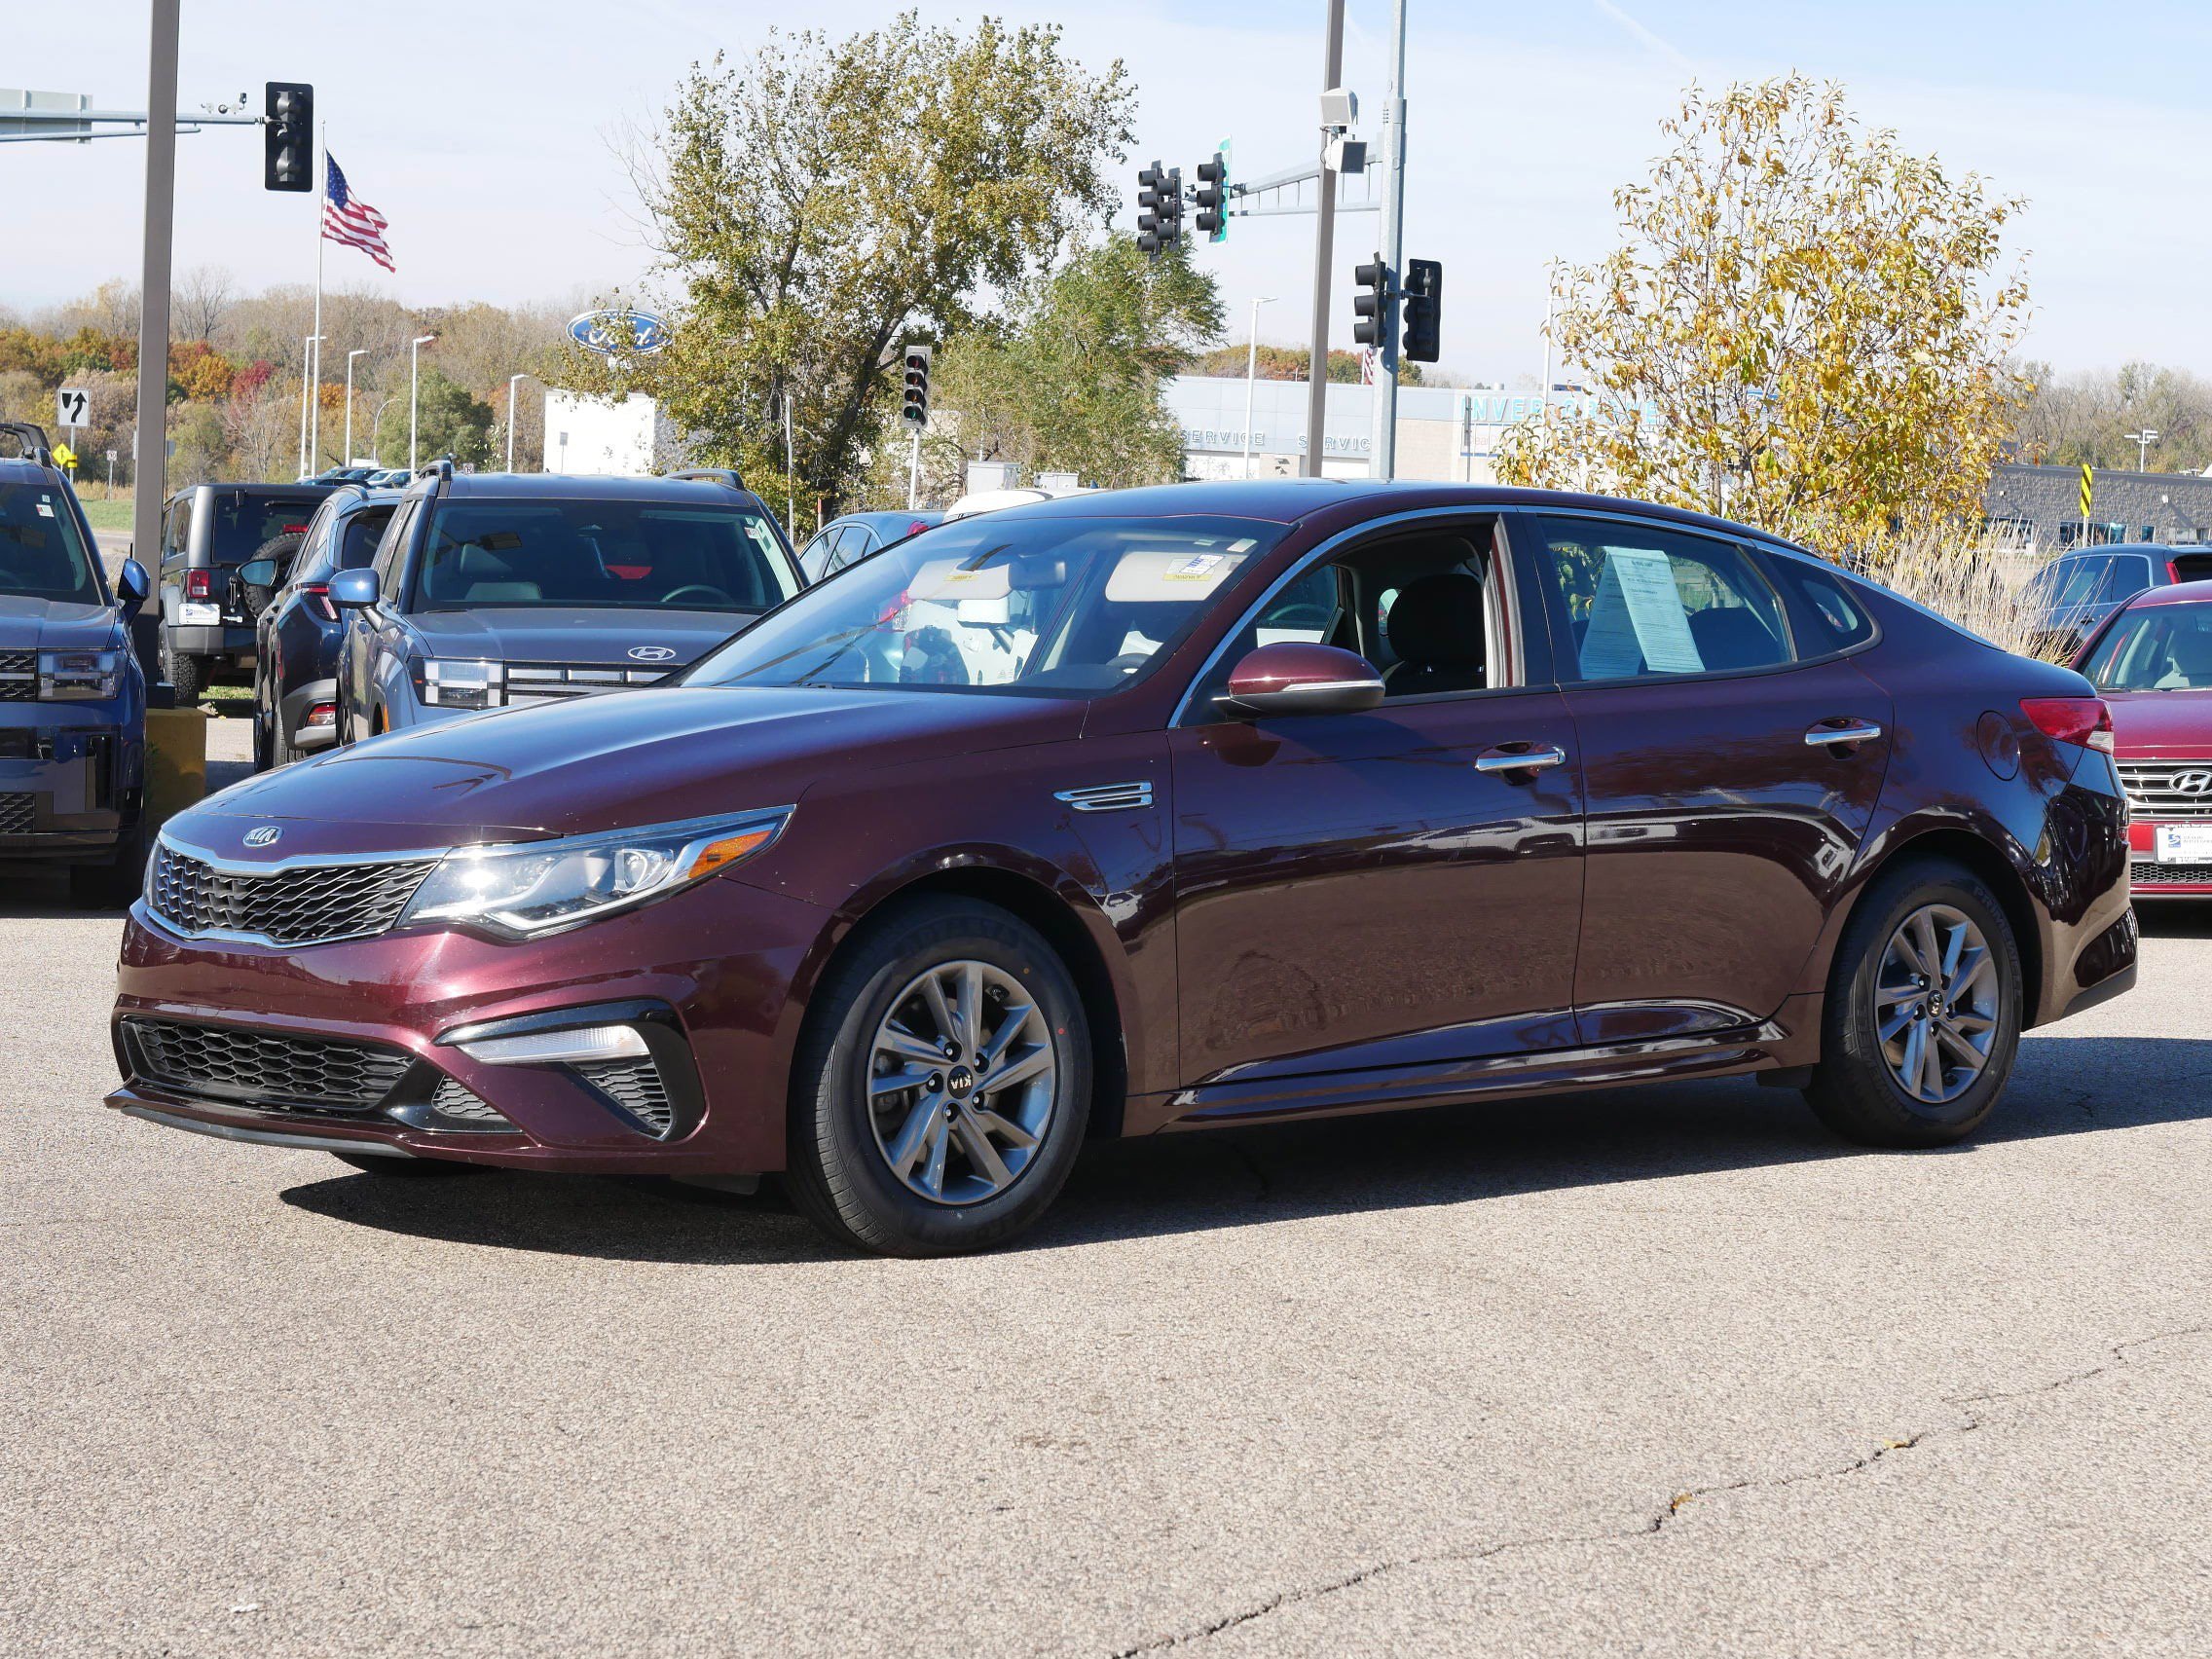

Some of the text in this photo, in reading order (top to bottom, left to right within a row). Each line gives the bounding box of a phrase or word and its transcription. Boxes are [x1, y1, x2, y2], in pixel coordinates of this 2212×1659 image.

[1298, 434, 1372, 451] SRVIC
[245, 828, 276, 843] KIA
[950, 1074, 972, 1089] KIA
